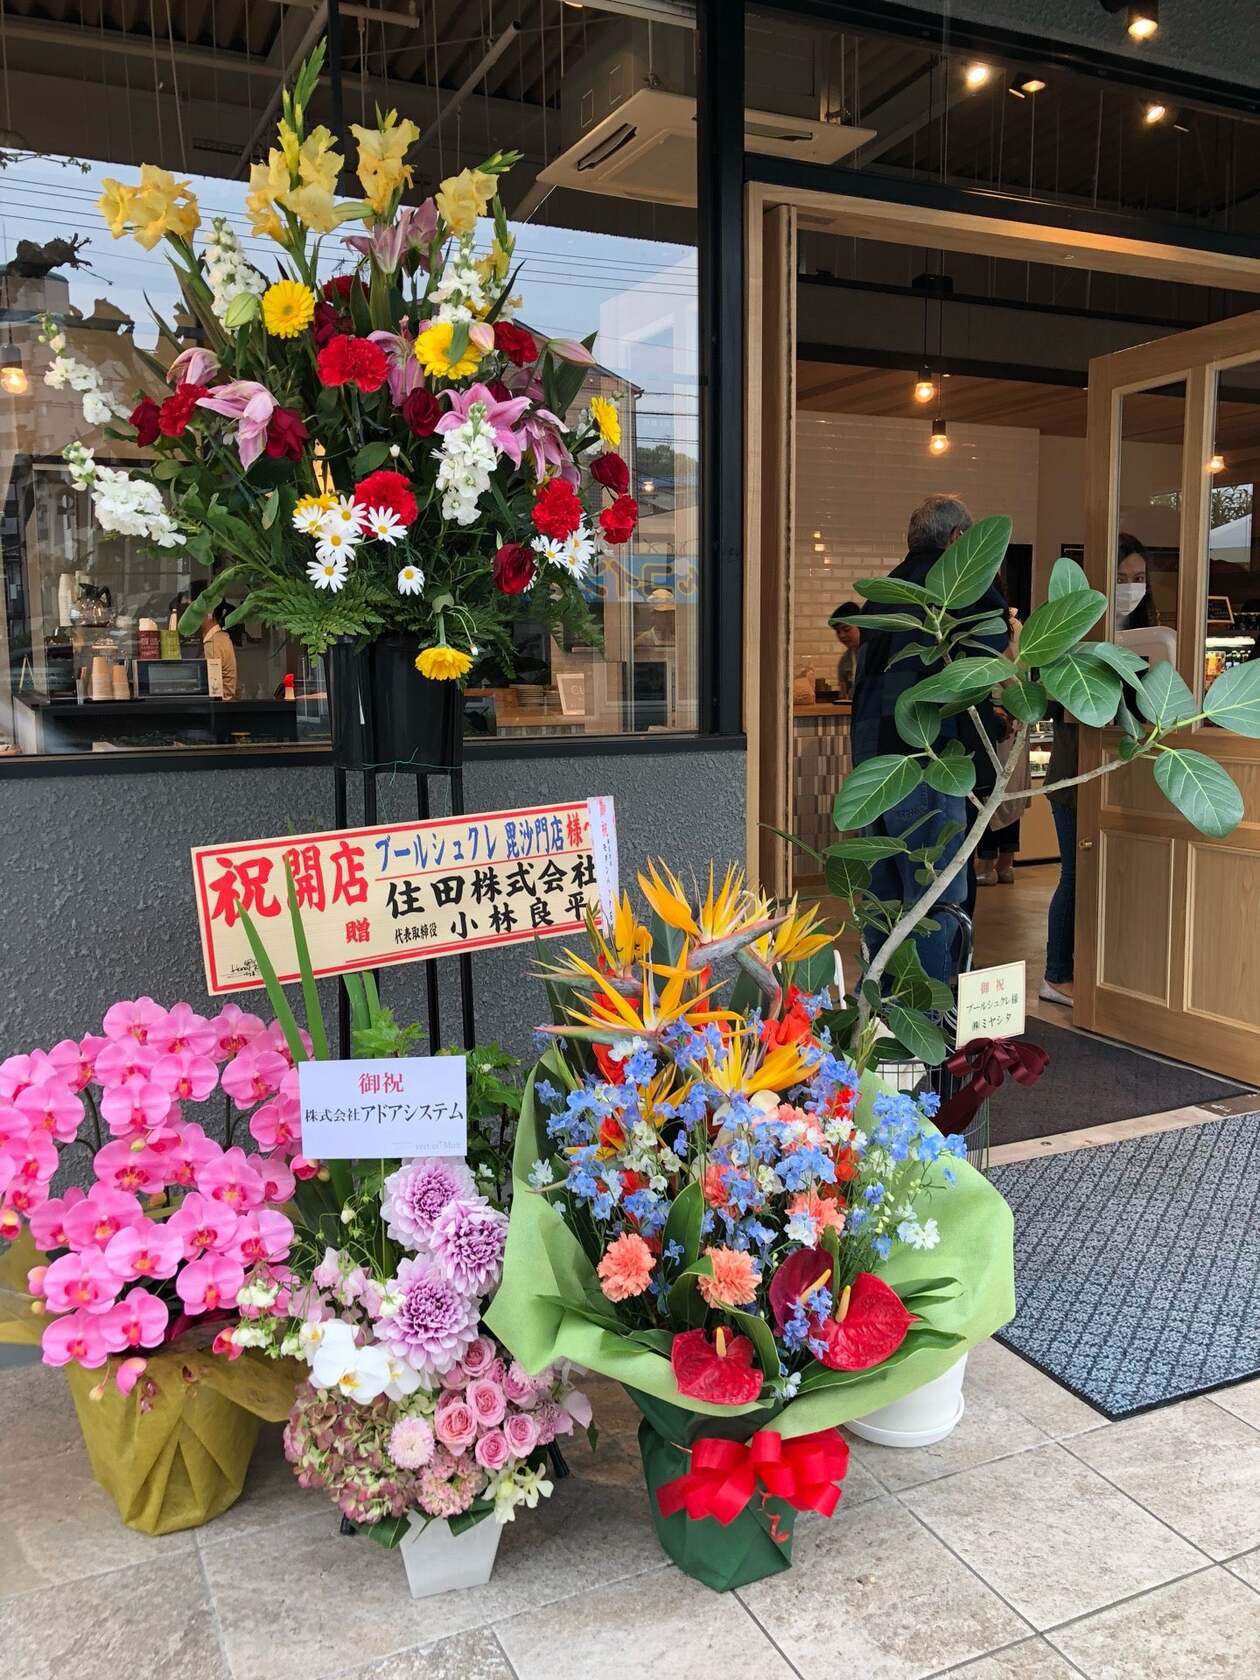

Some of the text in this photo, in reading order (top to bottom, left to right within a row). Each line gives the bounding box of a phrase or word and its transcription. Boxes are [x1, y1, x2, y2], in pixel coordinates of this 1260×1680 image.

[209, 840, 369, 928] 祝開店
[385, 854, 597, 919] 住田株式会社
[345, 917, 370, 944] 贈
[394, 891, 588, 944] 代表取締役 小林良平
[358, 1072, 404, 1095] 御祝
[305, 1102, 464, 1124] 株式会社アドアシステム
